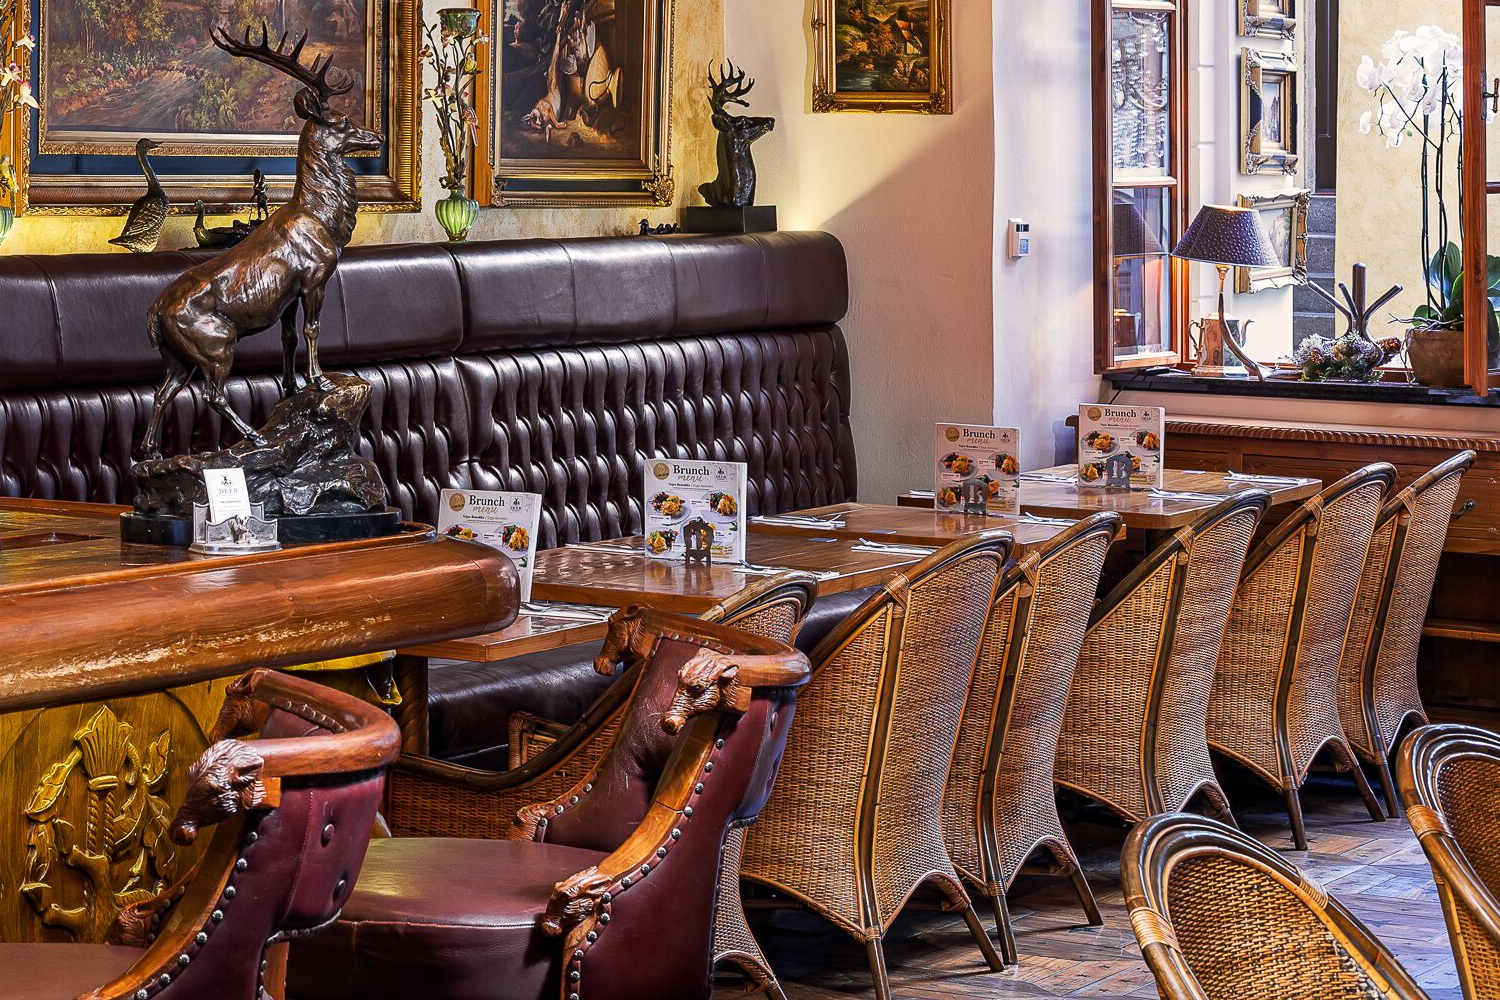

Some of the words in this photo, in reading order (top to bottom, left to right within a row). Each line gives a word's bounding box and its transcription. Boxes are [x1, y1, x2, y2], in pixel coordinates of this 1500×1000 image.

[1104, 408, 1137, 418] Brunch
[963, 428, 996, 439] Brunch
[673, 464, 710, 476] Brunch
[677, 474, 704, 483] menu
[468, 494, 505, 507] Brunch
[472, 505, 499, 514] menu
